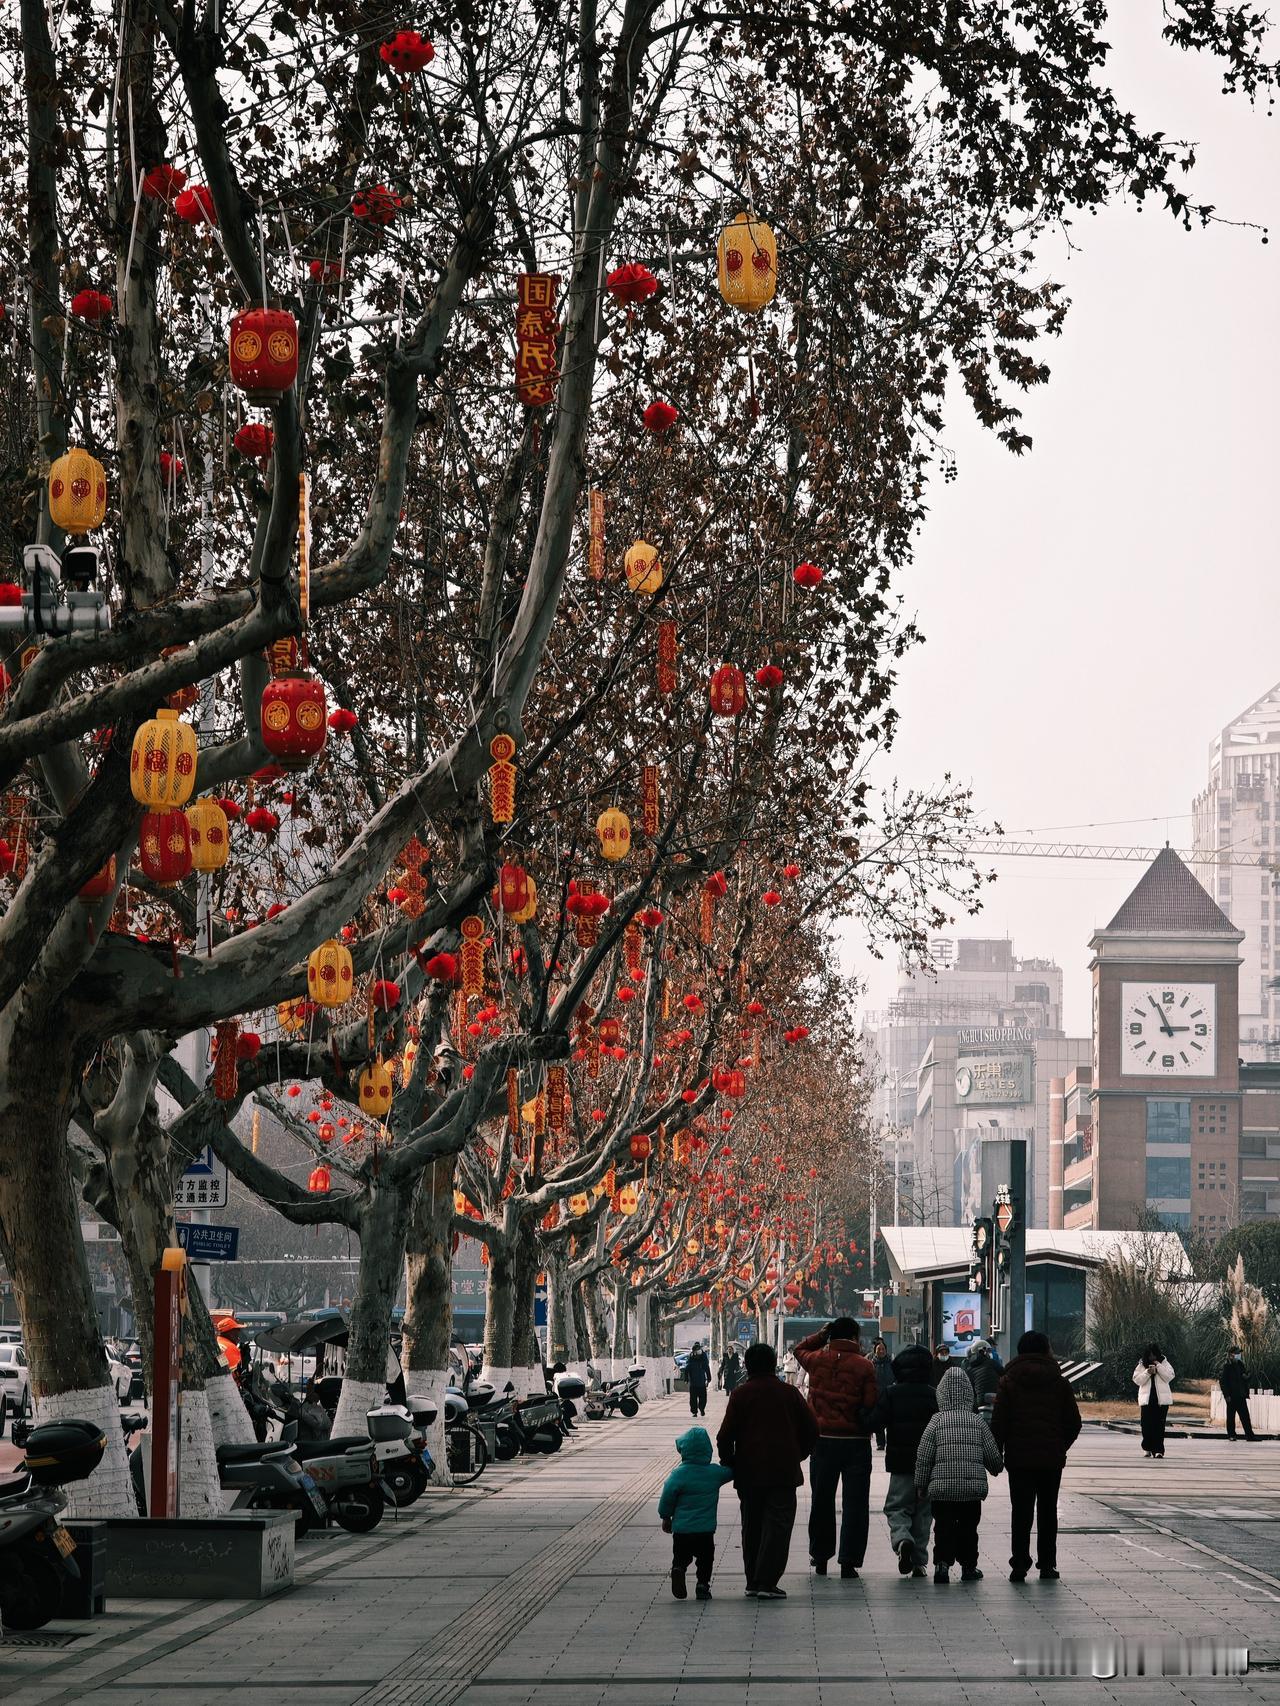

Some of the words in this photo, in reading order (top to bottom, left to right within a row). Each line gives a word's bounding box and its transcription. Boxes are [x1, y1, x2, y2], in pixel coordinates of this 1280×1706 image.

[519, 276, 551, 401] 国泰民安
[645, 767, 656, 833] 国泰民安
[579, 881, 593, 944] 国民安
[1163, 992, 1175, 1004] 12
[984, 1027, 1032, 1042] SHOPPING
[1130, 1023, 1142, 1035] 9
[1195, 1024, 1207, 1036] 3
[1162, 1055, 1174, 1067] 6
[176, 1179, 220, 1191] 前方监控
[175, 1192, 220, 1203] 交通违法
[192, 1229, 232, 1242] 公共卫生间
